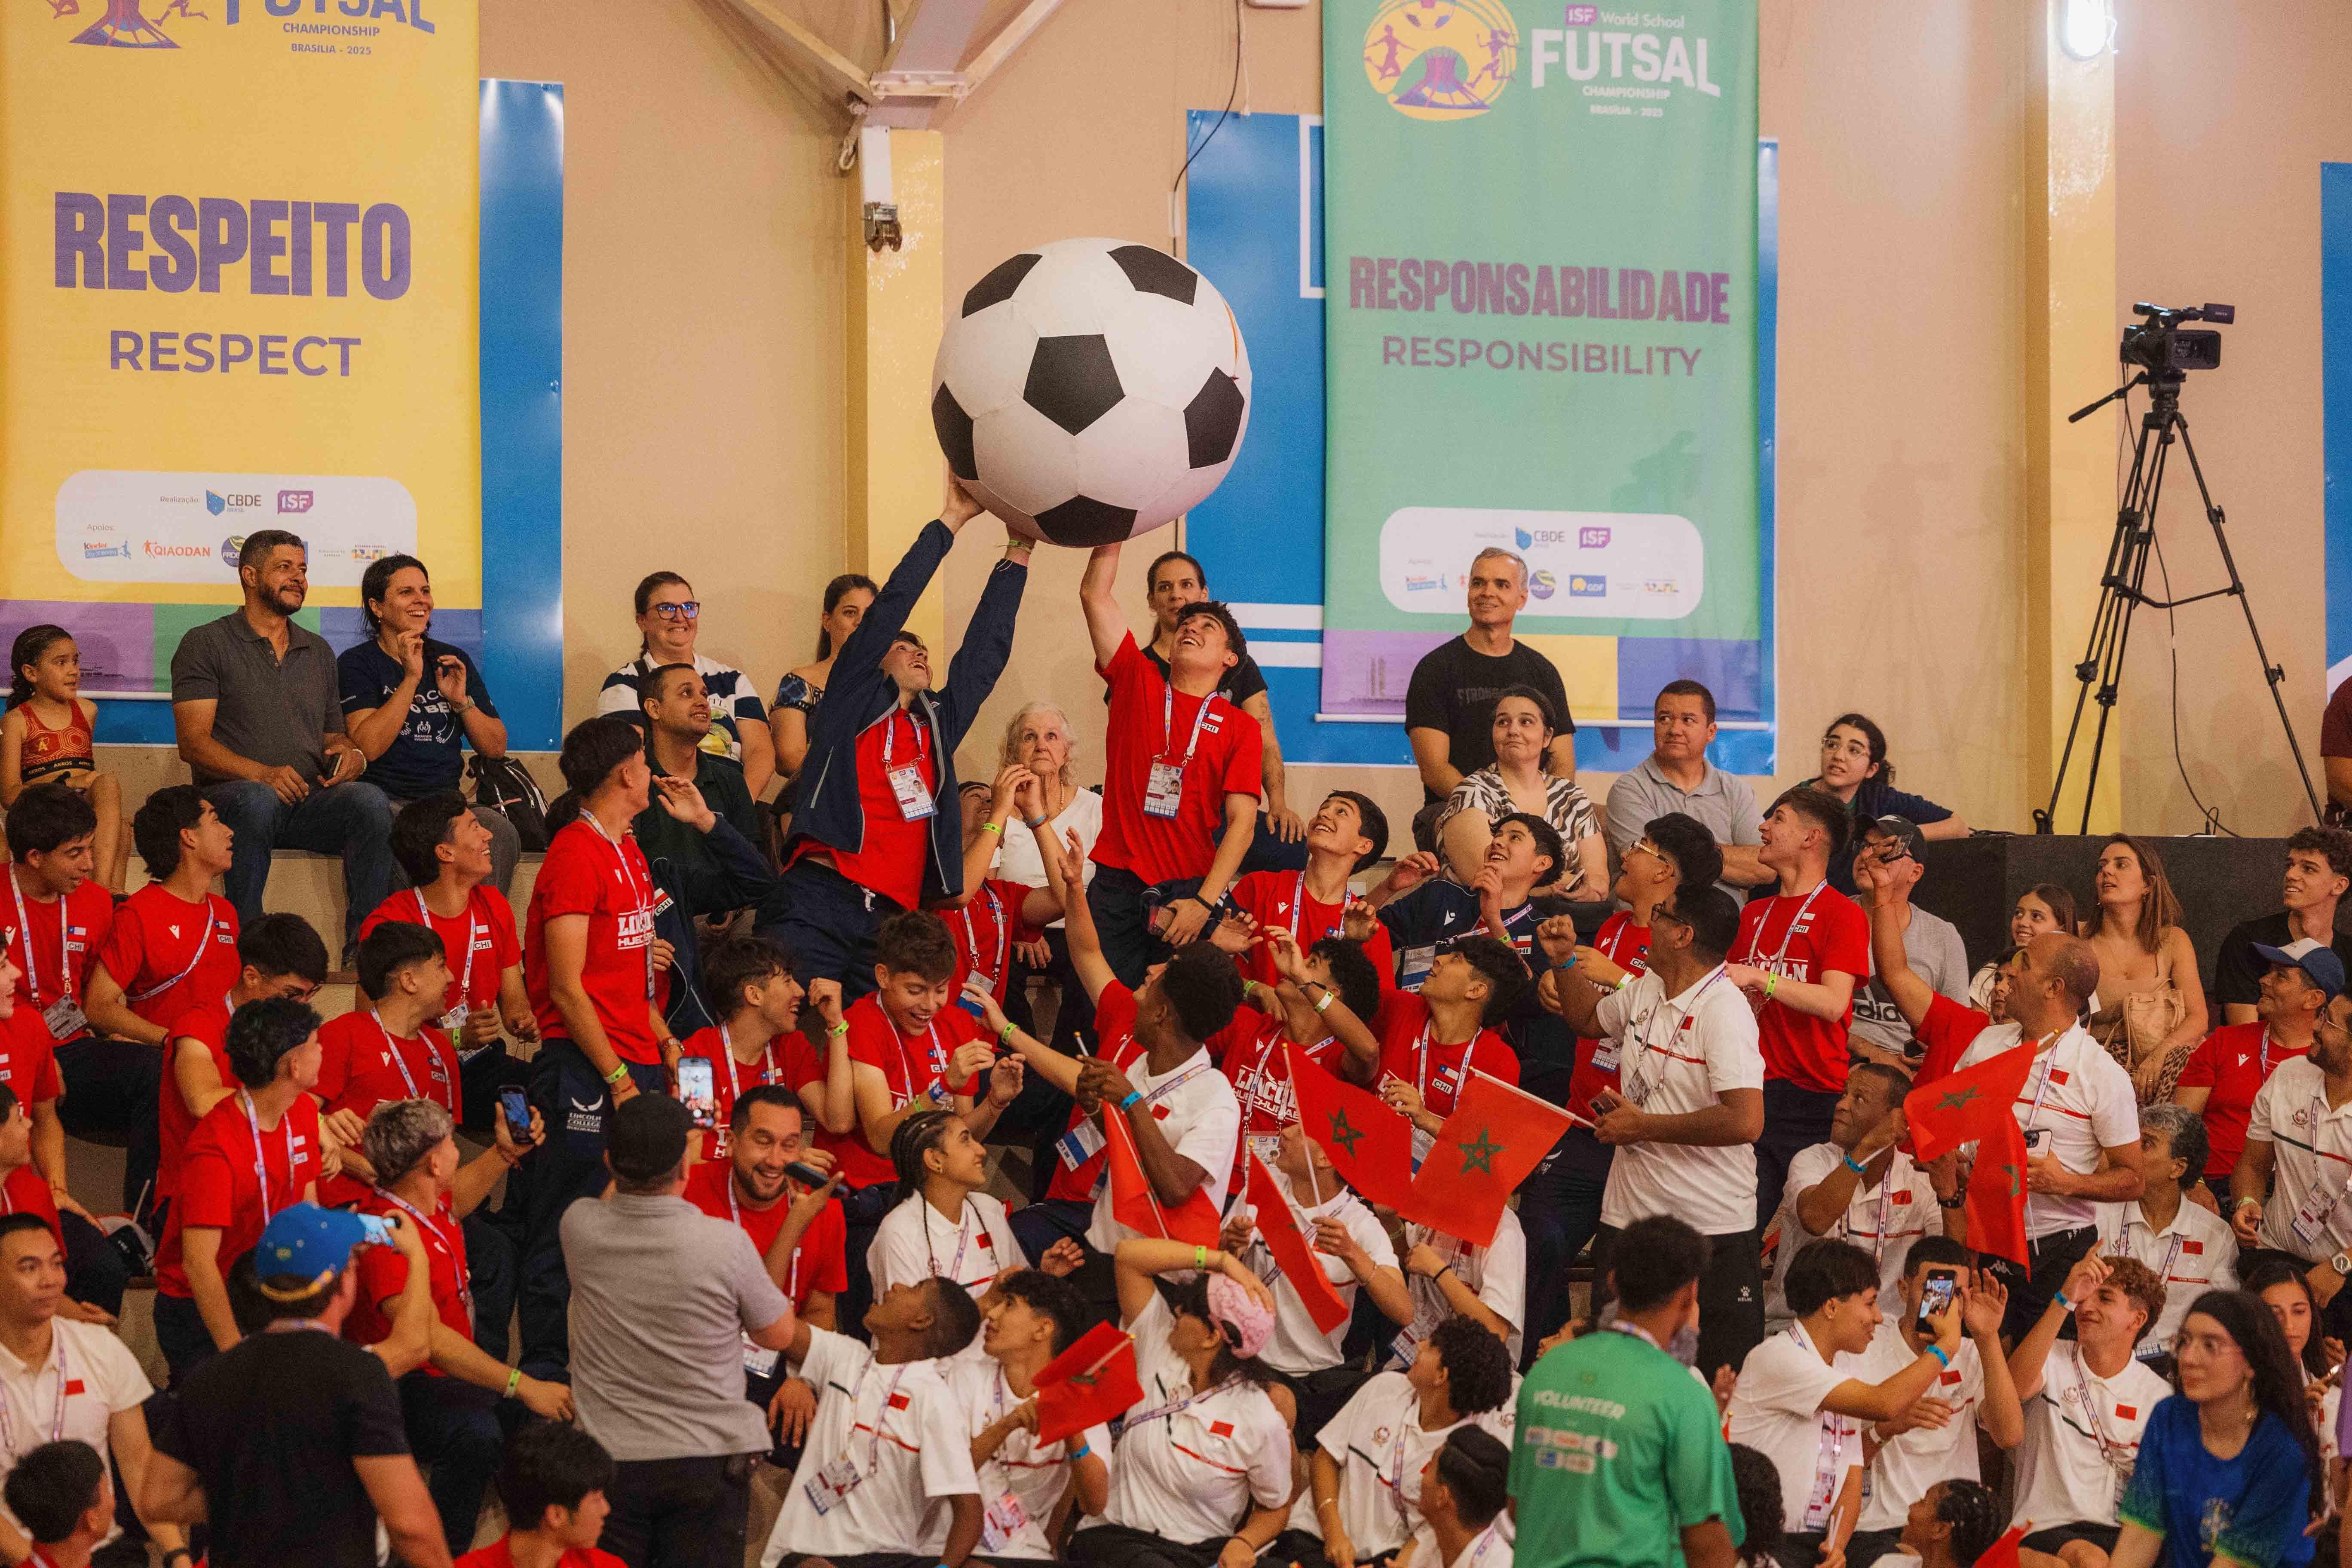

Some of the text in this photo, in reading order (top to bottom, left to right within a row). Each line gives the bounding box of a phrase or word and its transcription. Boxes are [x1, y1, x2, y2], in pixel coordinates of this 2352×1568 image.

[1568, 8, 1684, 28] ISF World School
[283, 22, 380, 37] CHAMPIONSHIP
[347, 46, 371, 55] 2025
[1531, 28, 1720, 98] FUTSAL
[1582, 86, 1671, 100] CHAMPIONSHIP
[55, 191, 411, 300] RESPEITO
[1349, 256, 1730, 325] RESPONSABILIDADE
[110, 330, 361, 377] RESPECT
[1382, 336, 1701, 377] RESPONSIBILITY
[227, 494, 262, 506] CBDE
[282, 494, 309, 509] ISF
[1534, 530, 1565, 542] CBDE
[1582, 531, 1607, 545] ISF
[155, 546, 210, 557] QIAODAN
[1202, 723, 1216, 732] CHI
[656, 900, 671, 913] CHI
[1434, 1081, 1449, 1092] CHI
[568, 1119, 601, 1128] COLLEGE
[570, 1112, 602, 1121] LINCOLN
[1533, 1390, 1626, 1419] VOLUNTEER
